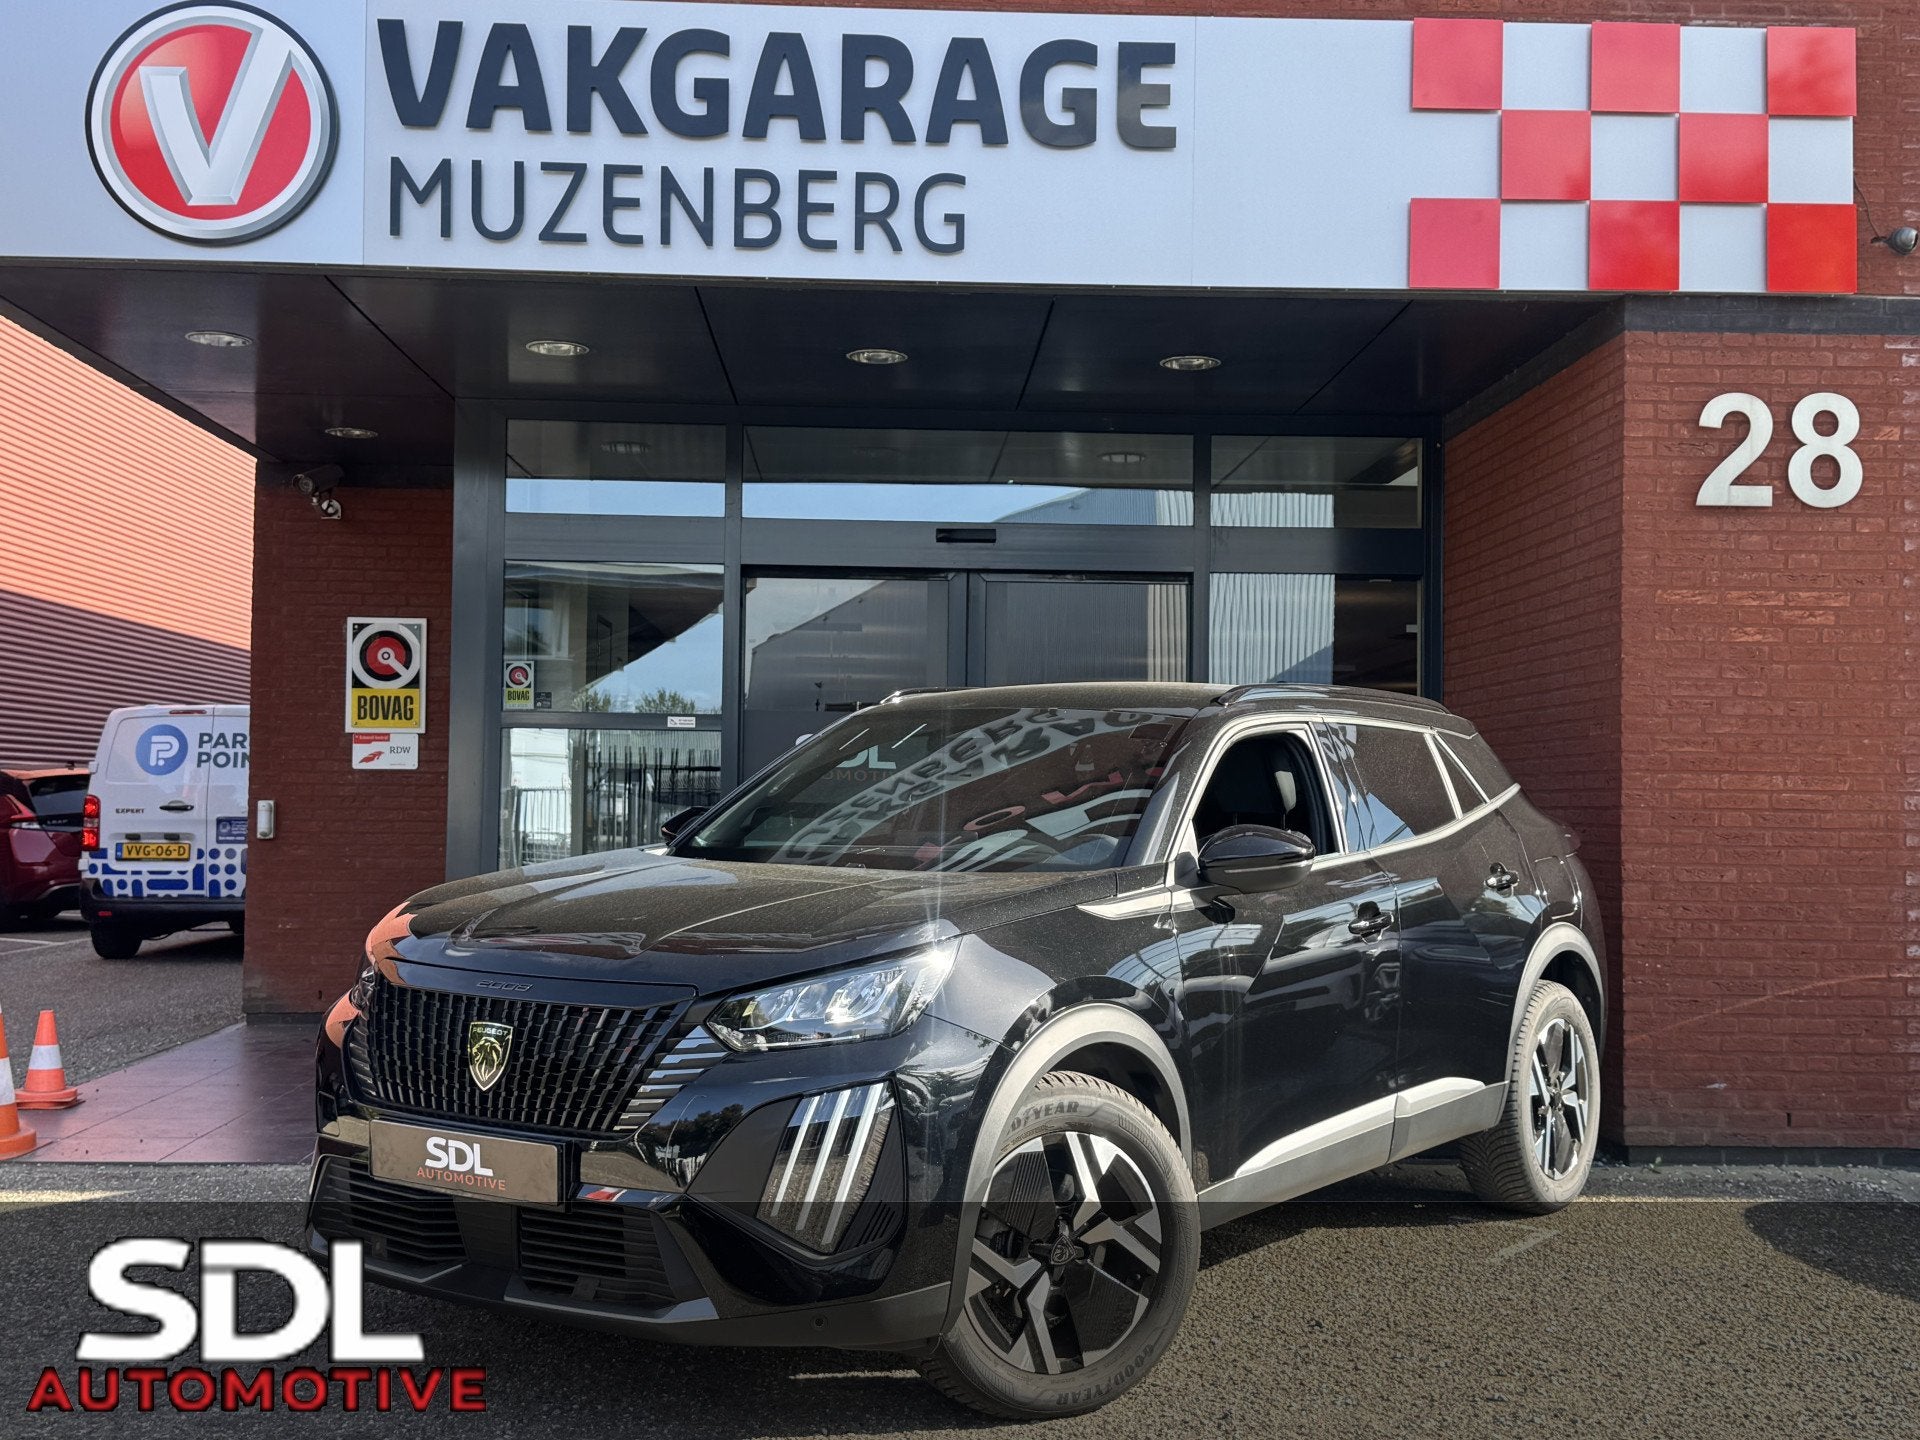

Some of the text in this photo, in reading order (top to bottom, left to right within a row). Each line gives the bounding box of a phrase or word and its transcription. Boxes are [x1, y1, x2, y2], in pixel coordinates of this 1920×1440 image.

[377, 18, 1177, 149] VAKGARAGE
[390, 156, 966, 254] MUZENBERG
[1696, 392, 1863, 509] 28
[357, 695, 414, 720] BOVAG
[507, 690, 530, 701] BOVAG
[389, 746, 412, 755] RDW
[126, 845, 187, 857] VVG-06-D
[476, 979, 534, 992] 2008
[472, 1026, 509, 1036] PEUGEOT
[424, 1136, 494, 1177] SDL
[416, 1166, 506, 1191] AUTOMOTIVE
